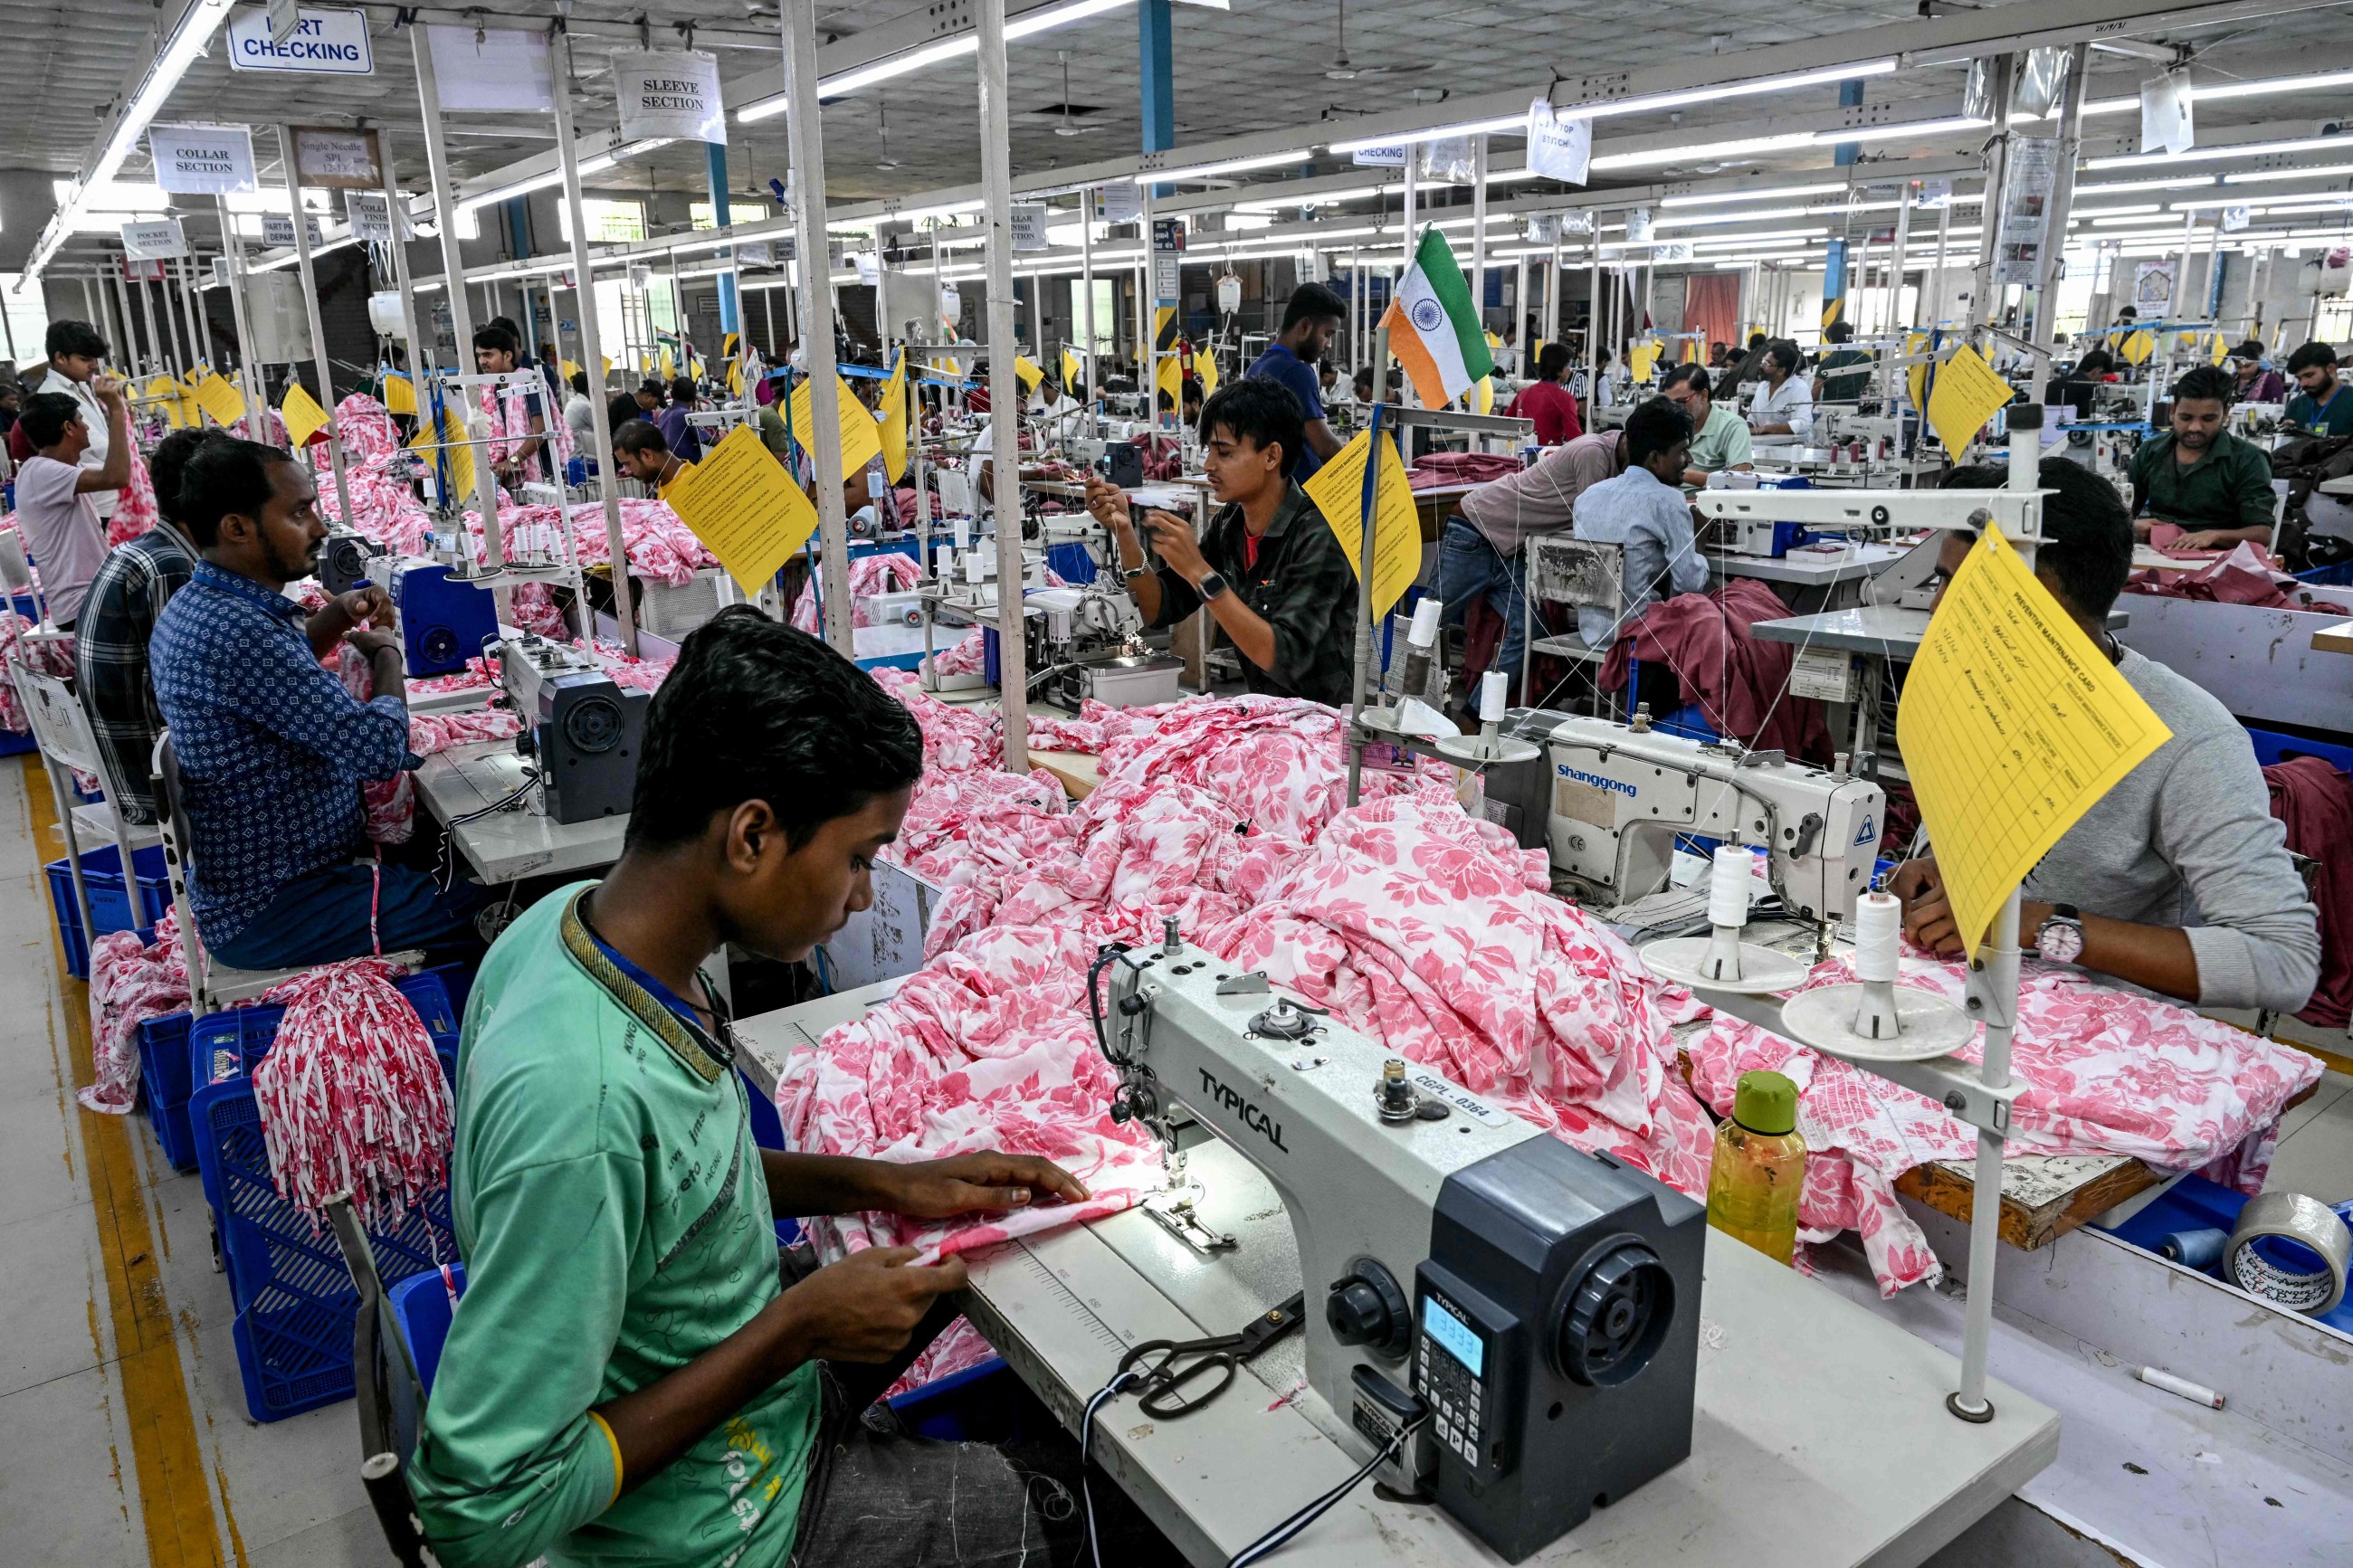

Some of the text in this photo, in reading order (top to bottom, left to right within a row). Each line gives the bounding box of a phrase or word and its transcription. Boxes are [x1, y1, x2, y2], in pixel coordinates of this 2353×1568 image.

[266, 16, 322, 36] RT
[243, 39, 359, 61] CHECKING
[643, 80, 699, 94] SLEEVE
[642, 96, 703, 109] SECTION
[300, 141, 362, 154] Single Needle
[1542, 135, 1568, 147] STITCH
[176, 148, 230, 159] COLLAR
[325, 152, 341, 162] SPI
[1358, 147, 1403, 158] CHECKING
[176, 161, 233, 172] SECTION
[322, 163, 348, 173] 12-13
[360, 204, 387, 213] COLL
[264, 223, 282, 232] PART
[137, 230, 169, 239] POCKET
[138, 237, 173, 247] SECTION
[1327, 463, 1344, 480] PREVENTIVE
[2012, 591, 2043, 629] PREVENTIVE
[2077, 671, 2096, 693] CARD
[1558, 764, 1637, 798] Shanggong
[623, 1021, 637, 1055] KING
[1415, 1074, 1447, 1098] CGPL
[1457, 1097, 1491, 1118] 0364
[1198, 1067, 1289, 1155] TYPICAL
[704, 1149, 722, 1187] PACING
[1057, 1269, 1070, 1279] 600
[1088, 1298, 1101, 1309] 650
[1435, 1292, 1469, 1326] TYPICAL
[1120, 1328, 1135, 1341] 700
